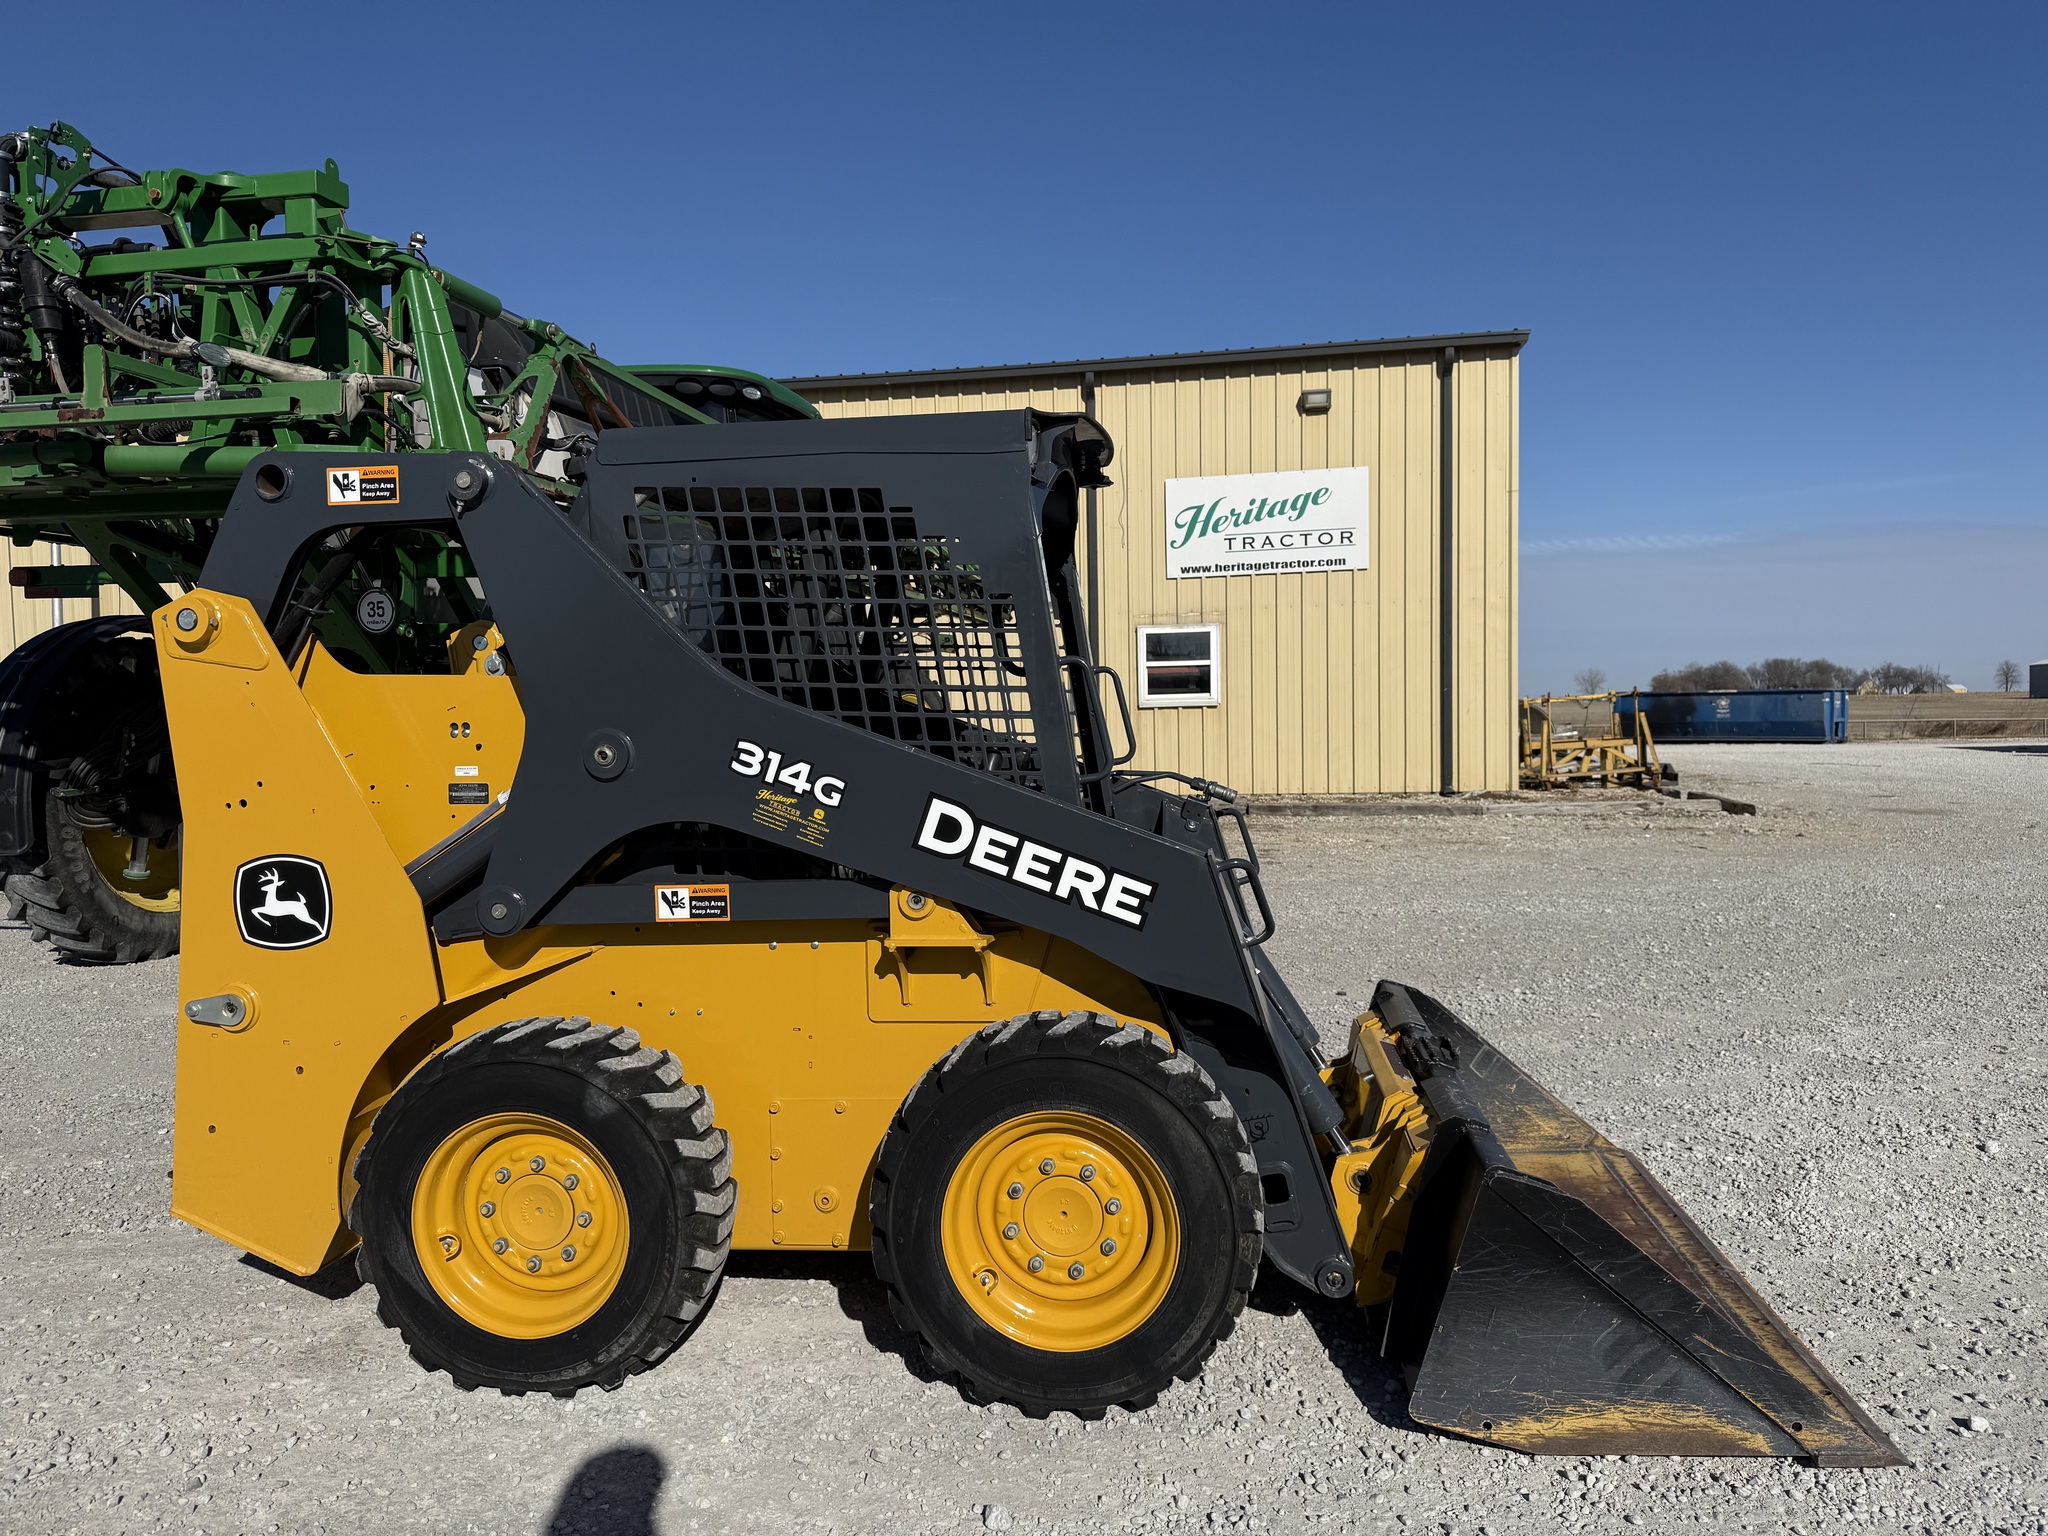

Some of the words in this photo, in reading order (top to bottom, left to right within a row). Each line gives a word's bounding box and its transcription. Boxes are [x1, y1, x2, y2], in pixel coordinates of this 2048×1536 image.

[1170, 487, 1332, 549] Heritage
[1224, 531, 1354, 550] TRACTOR
[1180, 558, 1346, 574] www.heritagetractor.com
[367, 601, 385, 618] 35
[730, 740, 846, 807] 314G
[756, 789, 798, 804] Heritage
[917, 797, 1153, 926] DEERE
